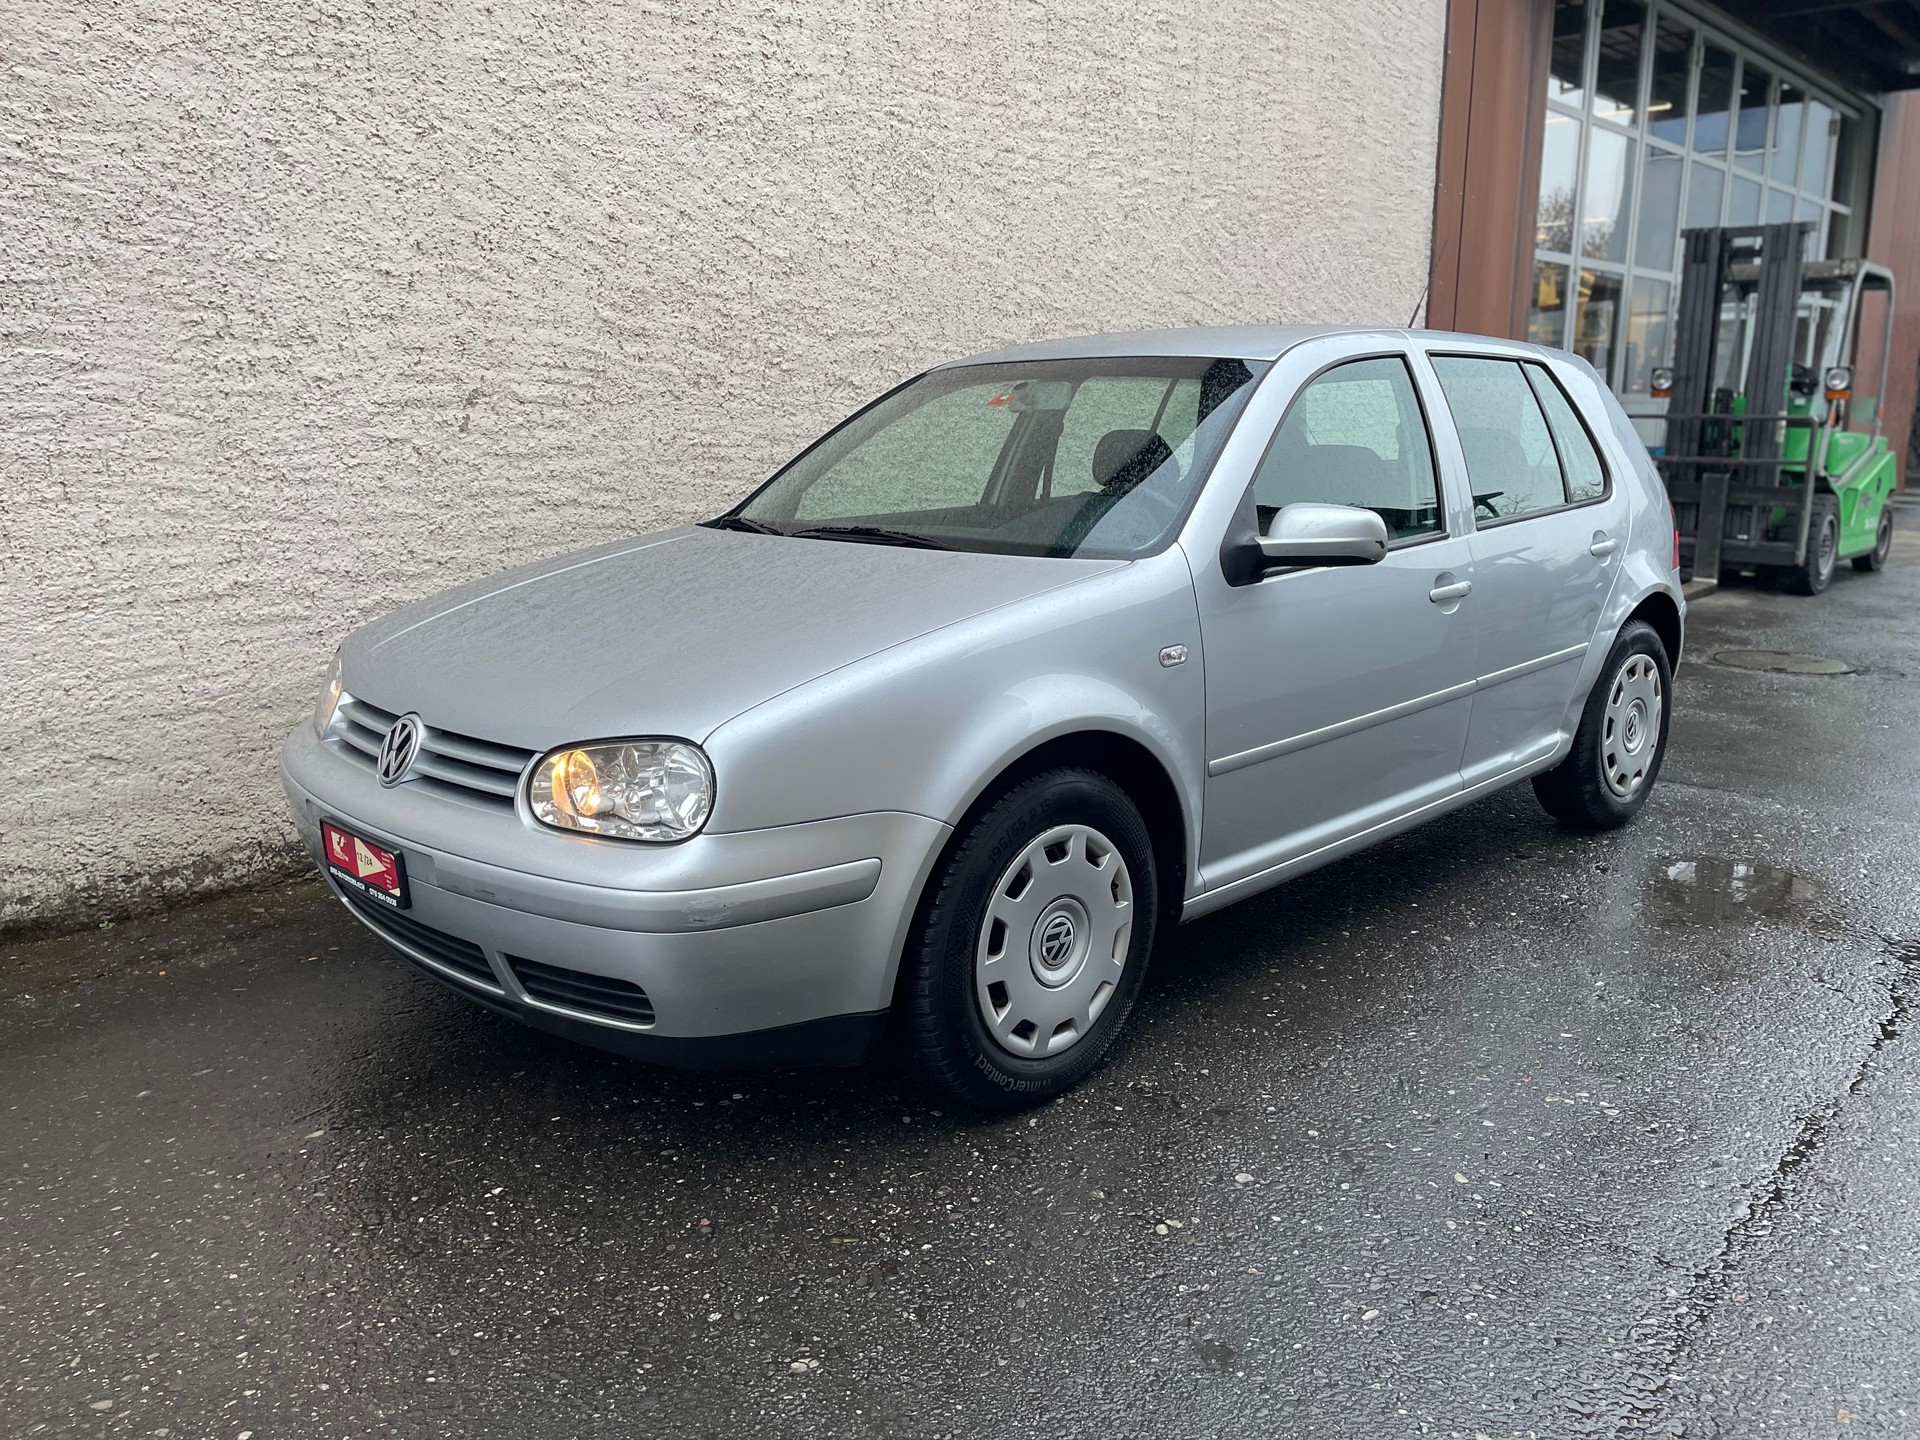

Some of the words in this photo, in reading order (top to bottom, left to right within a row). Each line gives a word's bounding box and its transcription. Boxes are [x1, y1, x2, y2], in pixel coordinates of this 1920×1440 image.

[379, 714, 418, 786] VW
[988, 815, 1026, 865] 195/65
[1028, 806, 1038, 821] R
[1042, 915, 1074, 966] VW
[974, 1053, 1053, 1092] WinterContact
